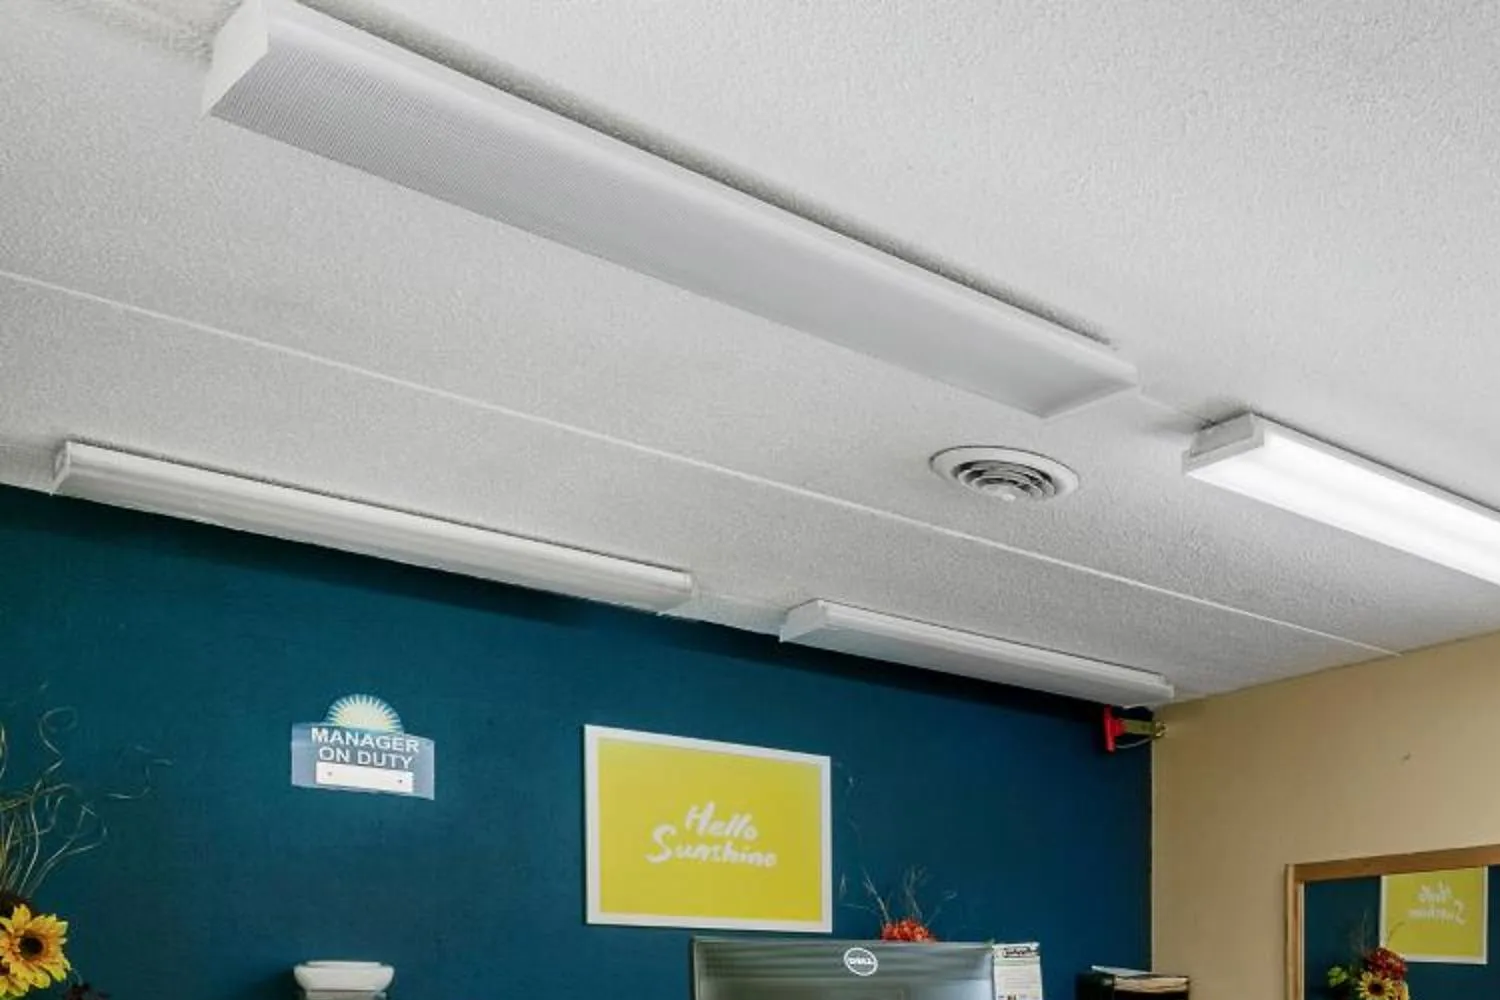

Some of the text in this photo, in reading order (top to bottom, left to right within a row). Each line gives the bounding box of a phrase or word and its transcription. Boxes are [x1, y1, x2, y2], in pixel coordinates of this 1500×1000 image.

[311, 727, 420, 753] MANAGER
[319, 746, 413, 769] ON DUTY
[684, 801, 758, 841] Hello
[643, 823, 778, 868] Sunshine
